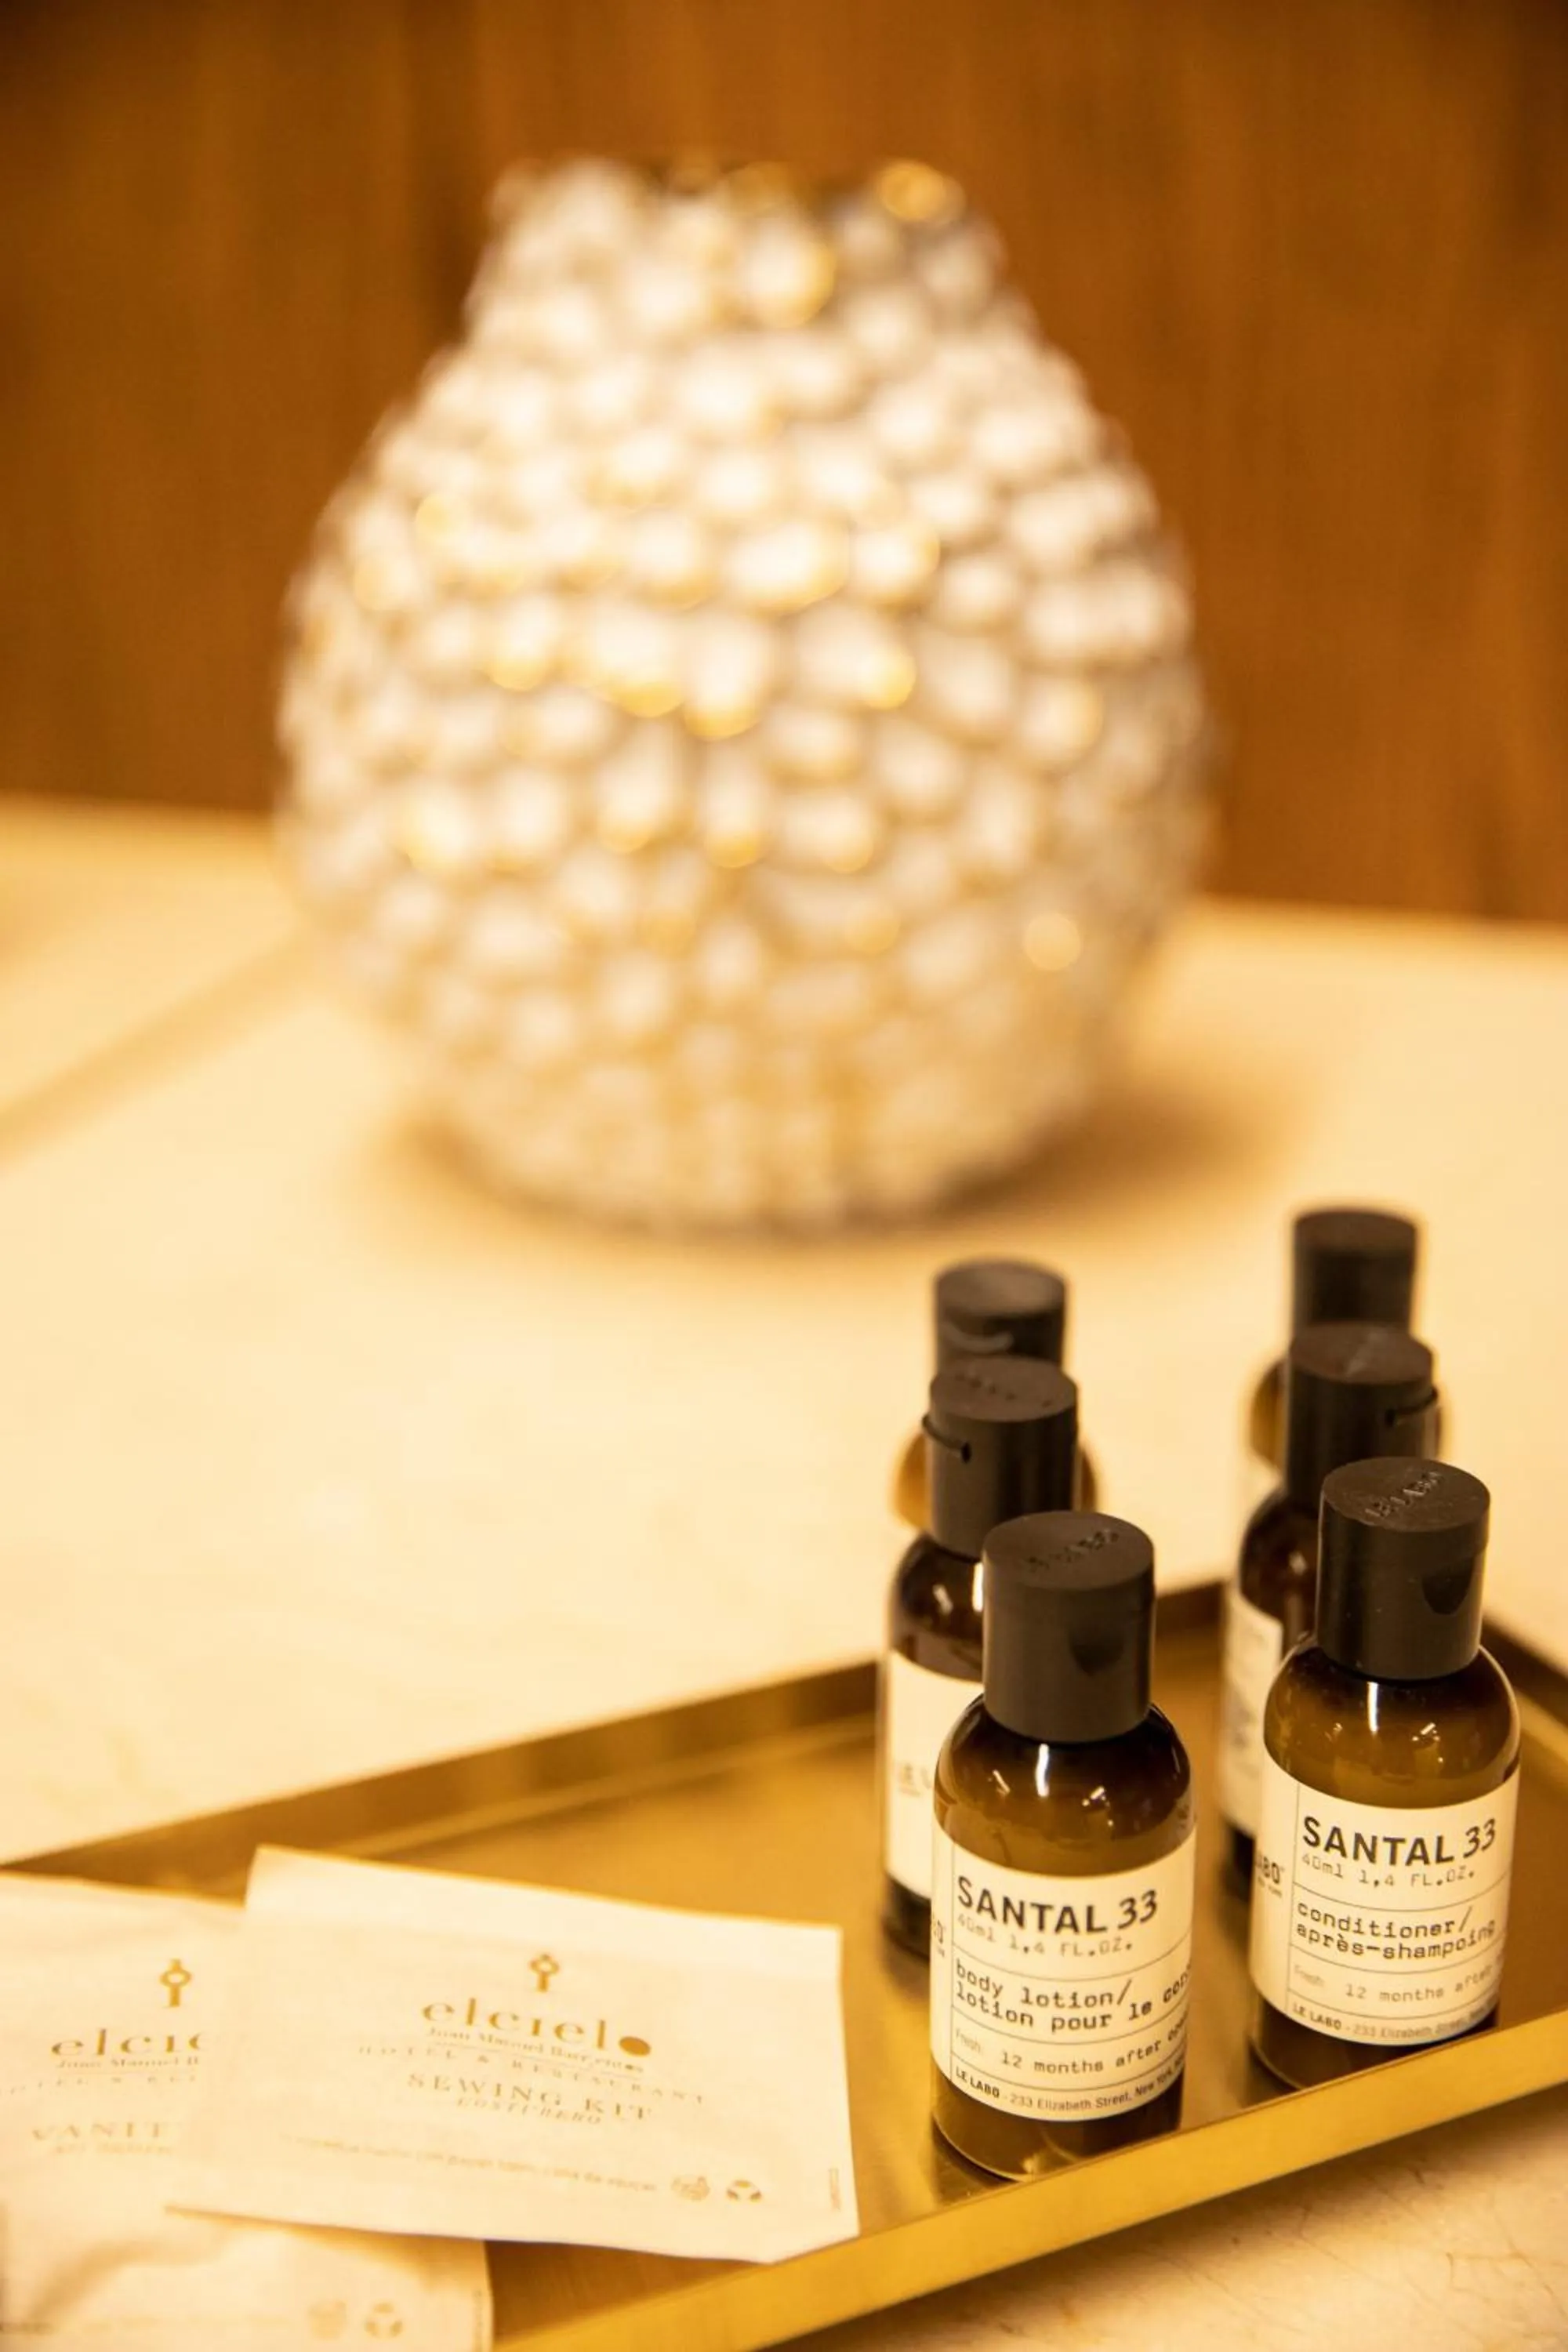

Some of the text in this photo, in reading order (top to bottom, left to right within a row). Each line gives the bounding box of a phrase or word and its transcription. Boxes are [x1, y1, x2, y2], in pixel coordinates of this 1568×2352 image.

[1302, 1816, 1497, 1867] SANTAL 33
[1302, 1853, 1344, 1879] 40ml
[957, 1875, 1108, 1936] SANTAL
[1117, 1889, 1158, 1930] 33
[1298, 1901, 1474, 1940] conditioner/
[956, 1914, 996, 1944] 40ml
[1297, 1920, 1497, 1960] après-shampoing
[956, 1958, 1133, 2010] body lotion/
[1345, 1984, 1367, 1999] 12
[1379, 1987, 1445, 2002] months
[956, 1981, 1035, 2028] lotion
[1051, 2012, 1113, 2037] pour
[1128, 2001, 1152, 2021] le
[1309, 2011, 1342, 2031] LABO
[1001, 2051, 1022, 2069] 12
[1033, 2058, 1104, 2075] months
[1116, 2039, 1162, 2068] after
[408, 2074, 652, 2121] SEWING KIT
[956, 2065, 968, 2083] LE
[970, 2077, 1000, 2100] LABO
[1010, 2093, 1033, 2109] 233
[1037, 2098, 1092, 2112] Elizabeth
